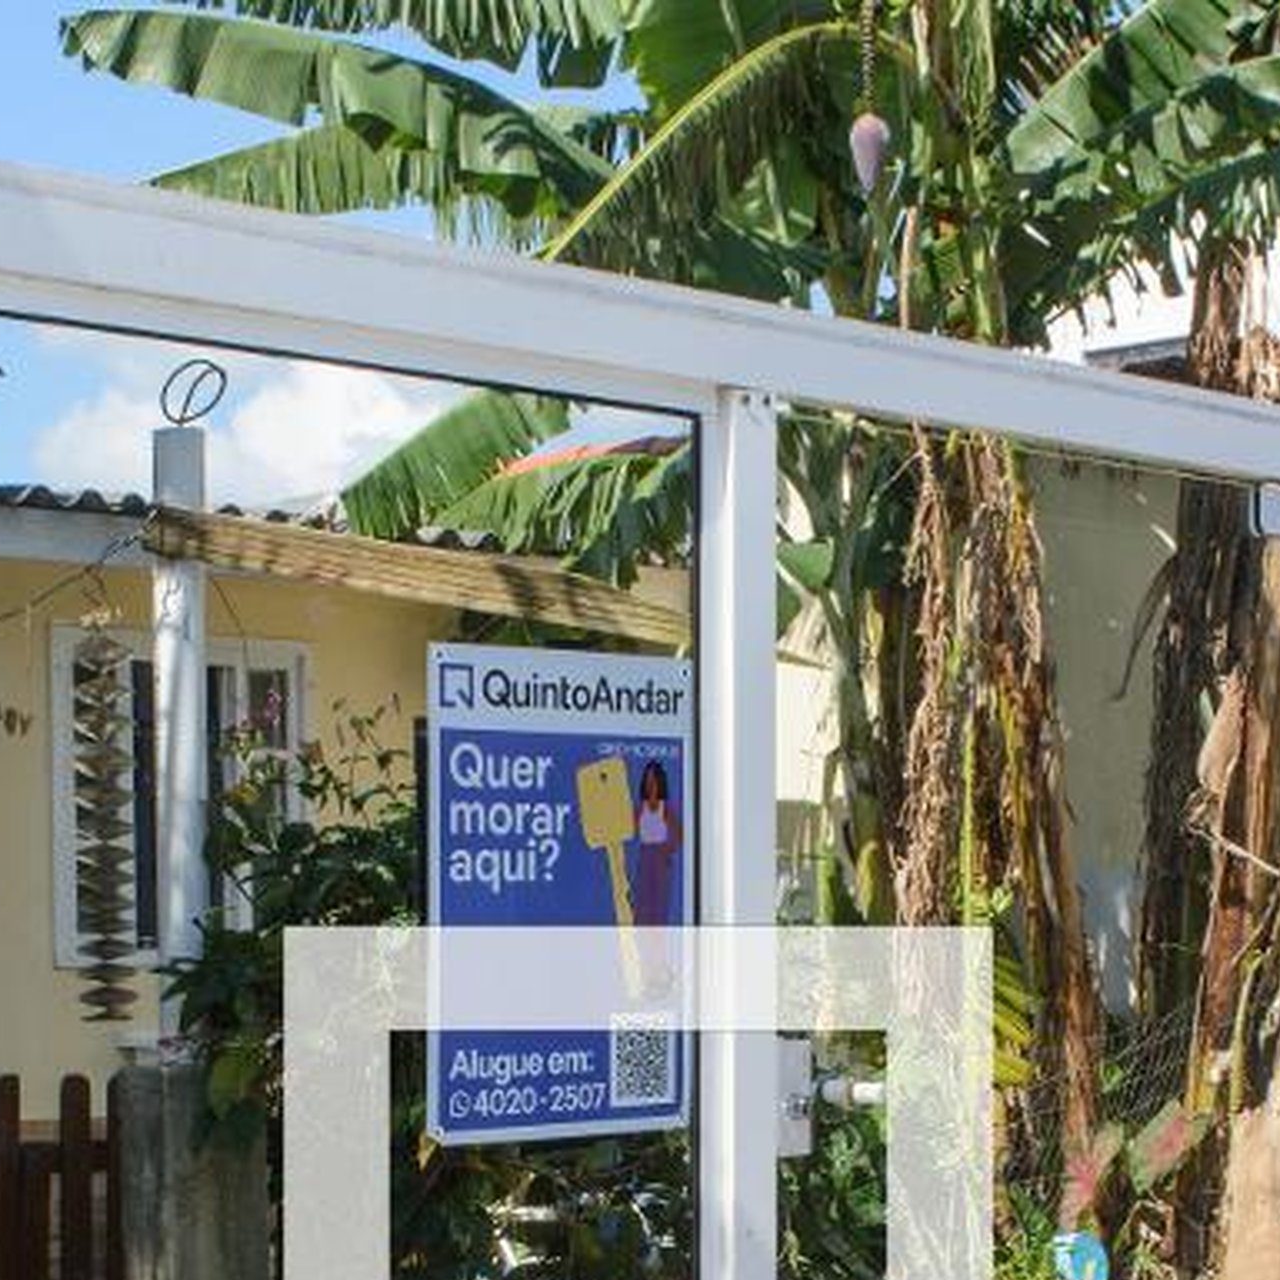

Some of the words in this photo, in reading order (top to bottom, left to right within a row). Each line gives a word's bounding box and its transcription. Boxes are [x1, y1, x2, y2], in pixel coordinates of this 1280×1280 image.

[482, 669, 684, 715] QuintoAndar
[449, 742, 552, 790] Quer
[449, 800, 570, 835] morar
[449, 839, 560, 894] aqui?
[449, 1050, 544, 1085] Alugue
[547, 1050, 595, 1074] em:
